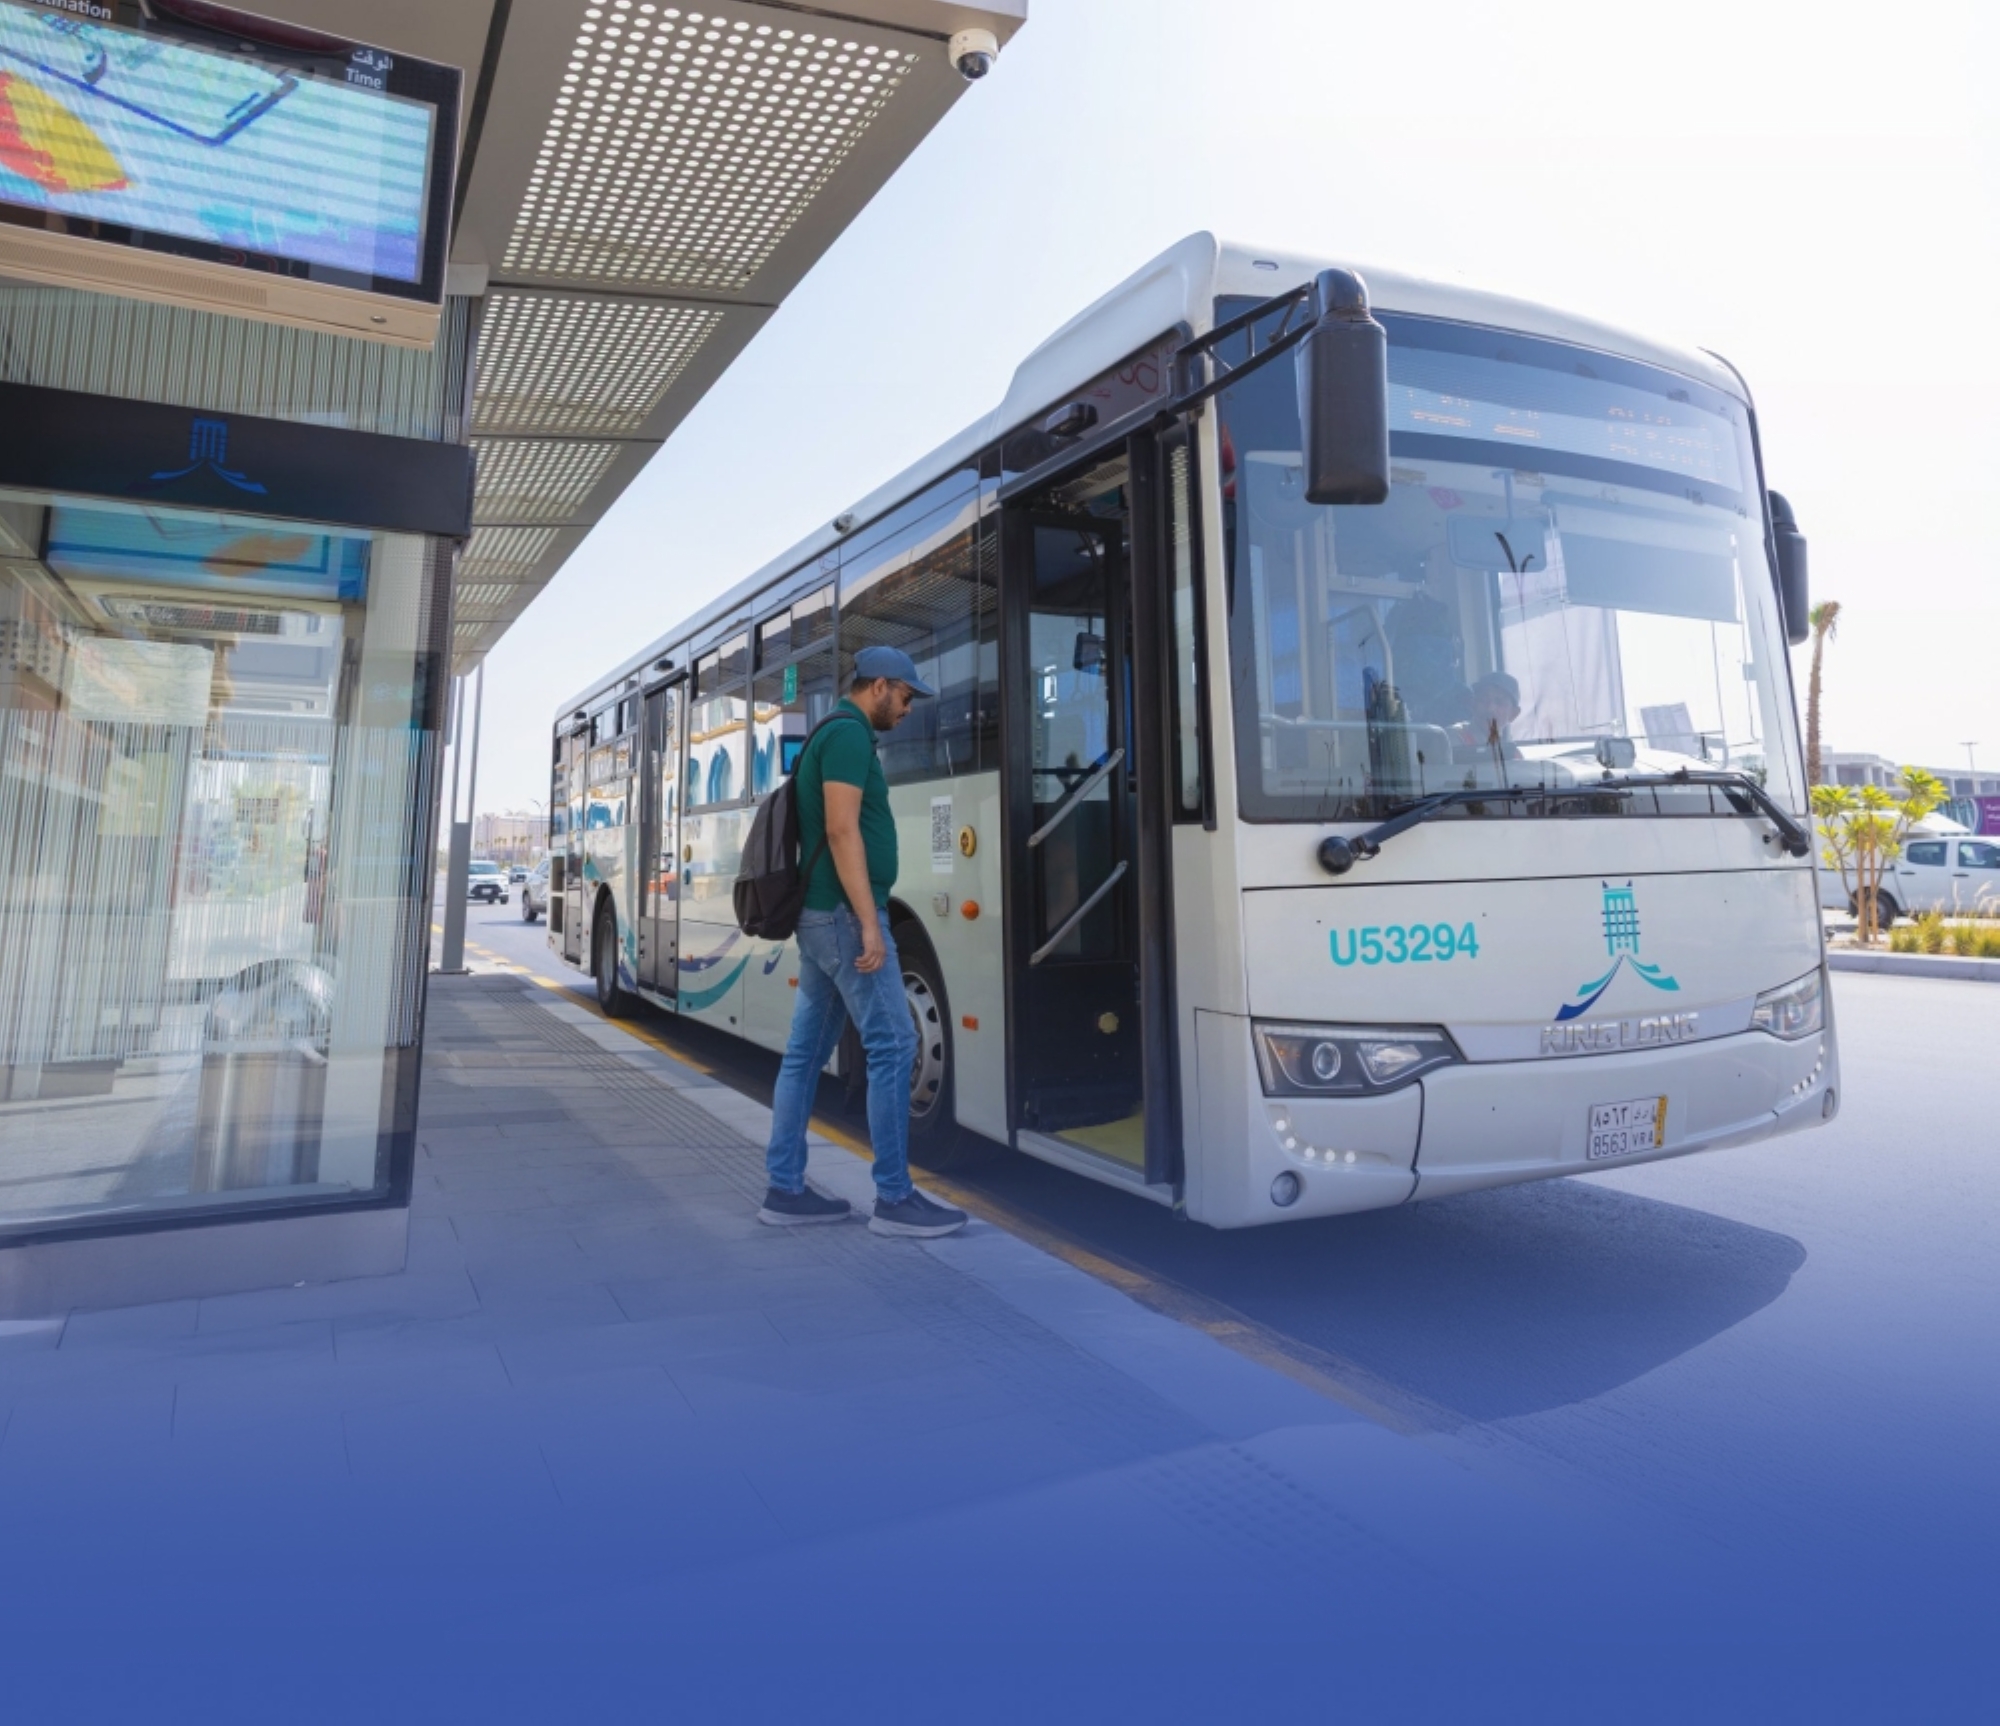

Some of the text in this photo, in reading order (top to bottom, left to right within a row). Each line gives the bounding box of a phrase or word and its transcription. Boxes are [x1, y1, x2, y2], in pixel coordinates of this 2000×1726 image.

[351, 50, 393, 71] الوقت
[346, 67, 382, 90] Time
[1329, 921, 1480, 967] U53294
[1540, 1011, 1700, 1055] KING LONG
[1593, 1131, 1628, 1157] 8563
